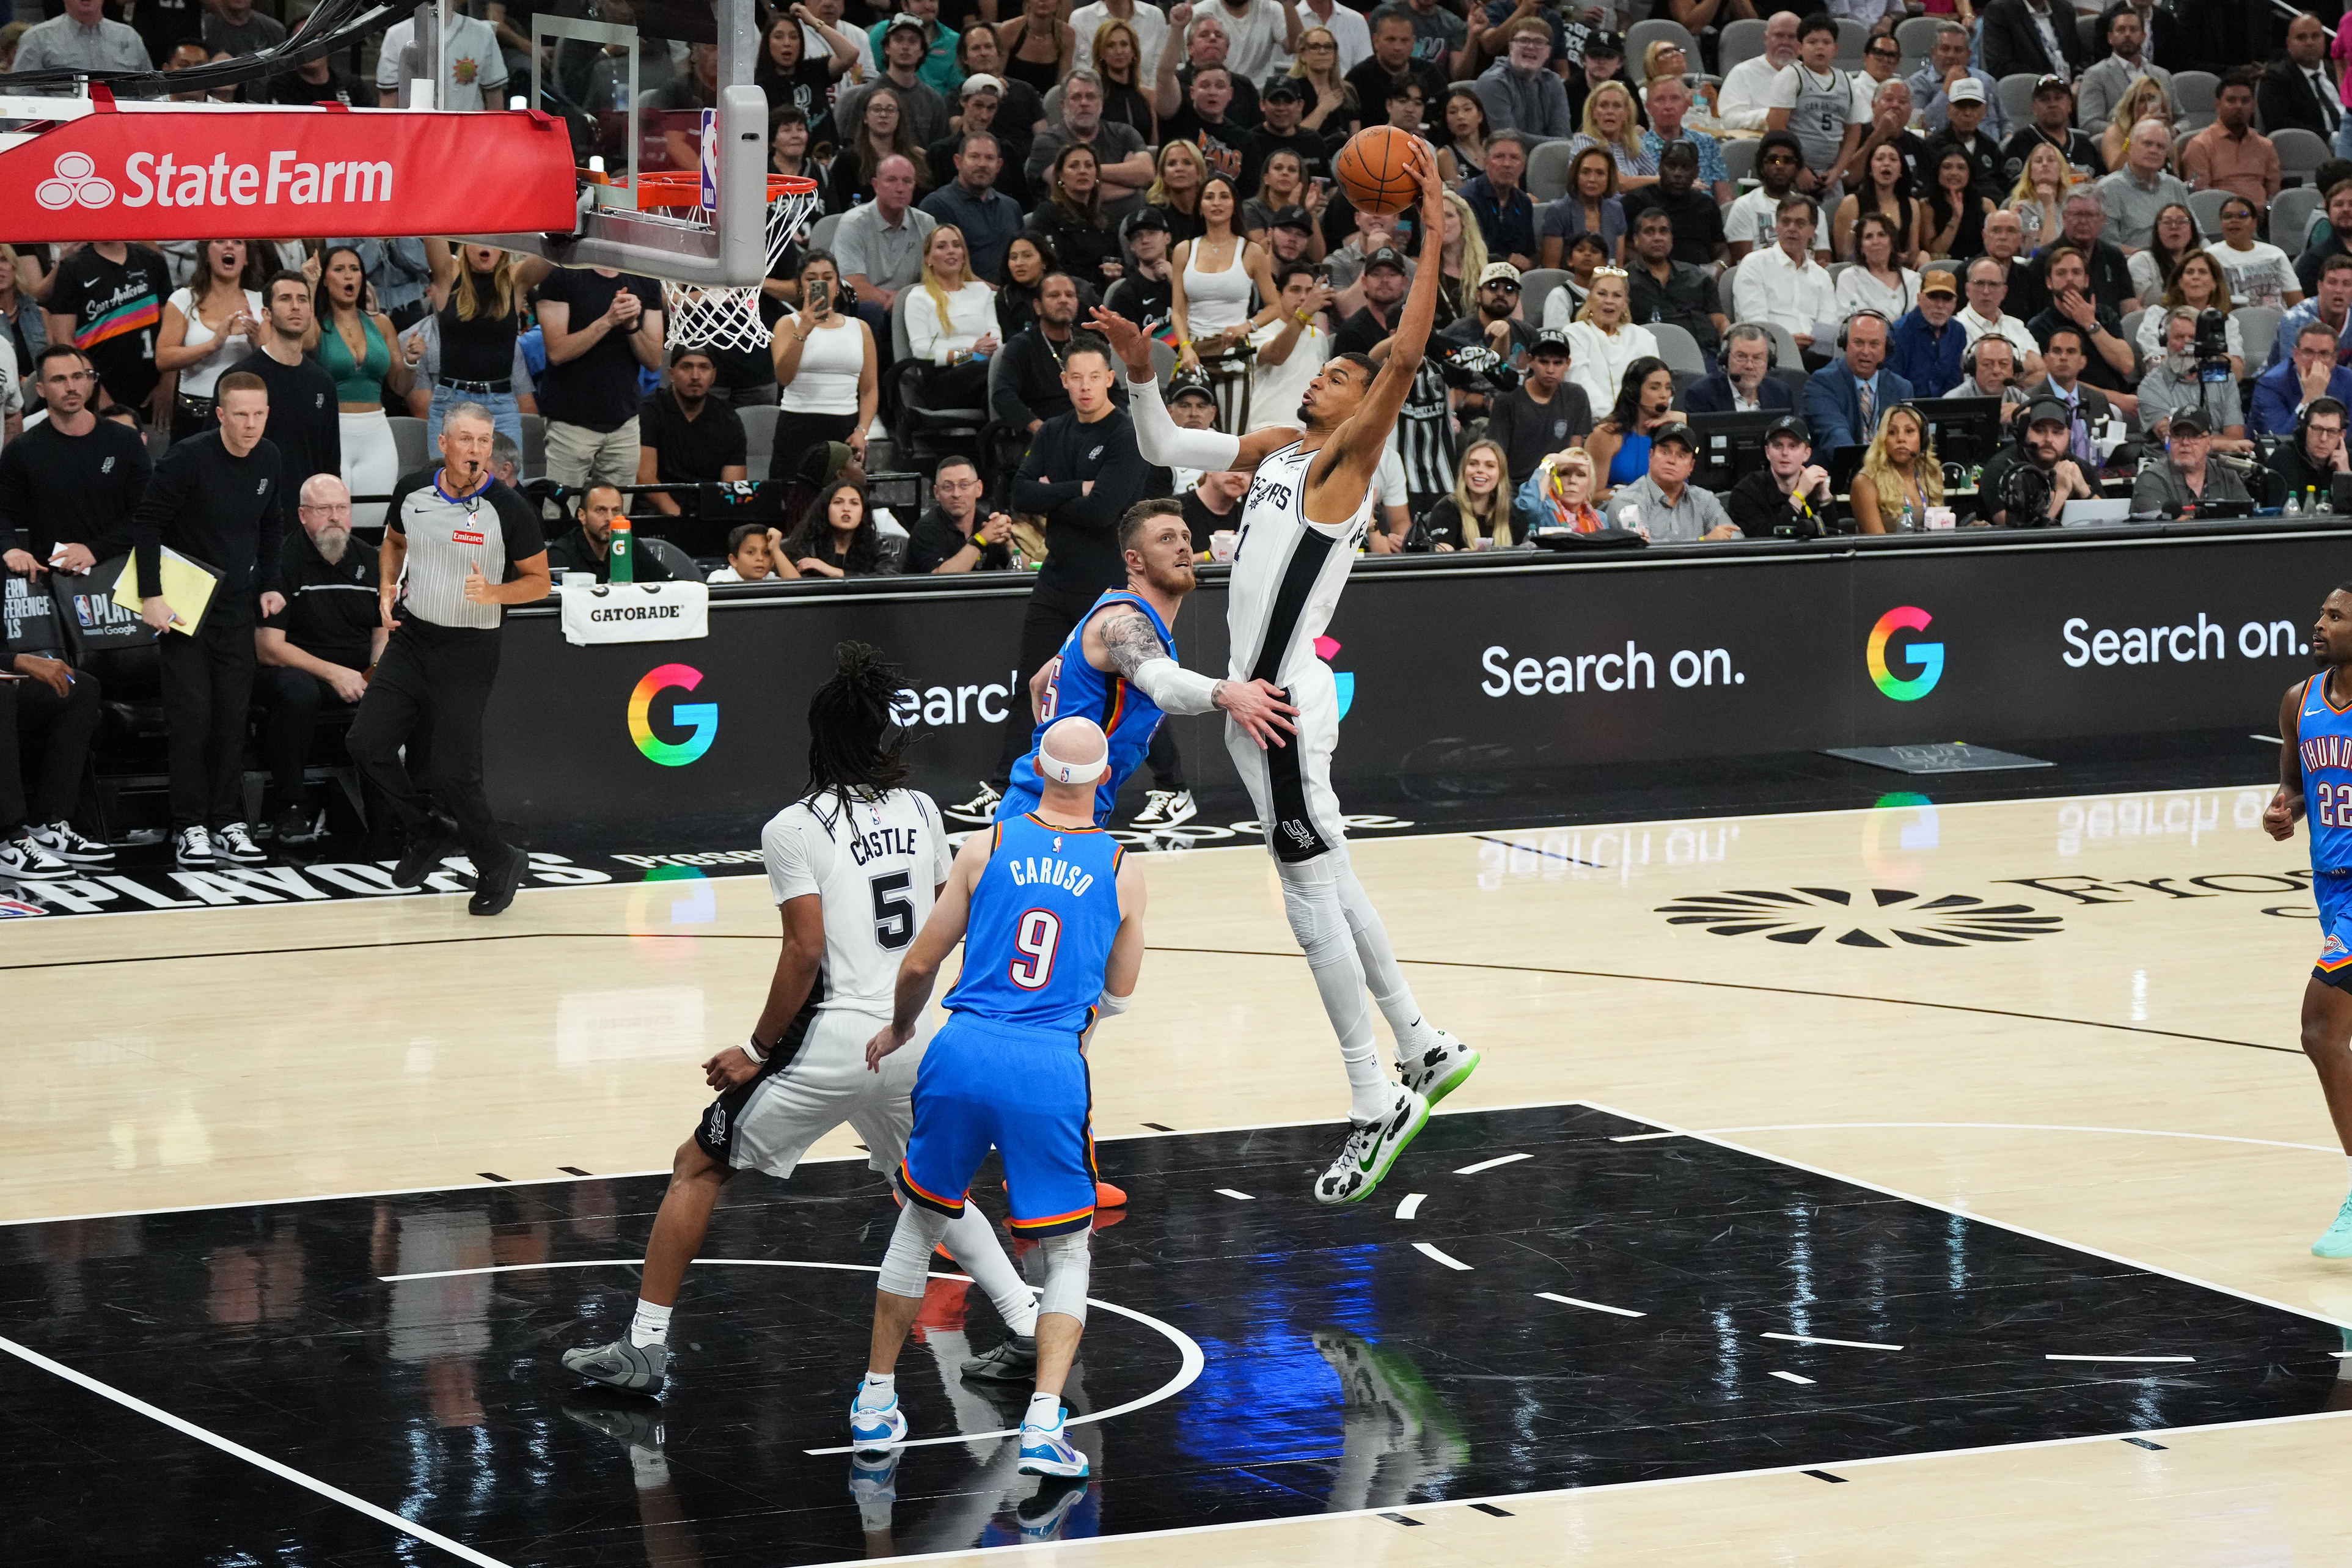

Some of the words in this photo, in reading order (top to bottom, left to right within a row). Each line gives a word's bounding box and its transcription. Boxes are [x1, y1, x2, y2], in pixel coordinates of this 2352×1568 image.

[1822, 114, 1832, 131] 5
[703, 187, 714, 205] NBA
[140, 328, 154, 359] 1
[1540, 331, 1566, 343] SAS
[453, 532, 483, 543] Emirates
[612, 540, 626, 555] G
[1233, 522, 1251, 564] 1
[90, 593, 142, 625] PLA
[104, 623, 137, 635] Google
[591, 605, 680, 622] GATORADE
[1866, 606, 1945, 702] G
[2062, 612, 2225, 668] Search
[2238, 620, 2309, 658] on.
[1481, 640, 1655, 698] Search
[1669, 648, 1745, 687] on.
[628, 663, 719, 767] G
[888, 670, 1017, 727] earc
[2299, 735, 2352, 775] THUND
[2317, 781, 2352, 829] 22
[850, 827, 917, 866] CASTLE
[1009, 857, 1094, 898] CARUSO
[868, 867, 917, 953] 5
[1009, 907, 1063, 992] 9
